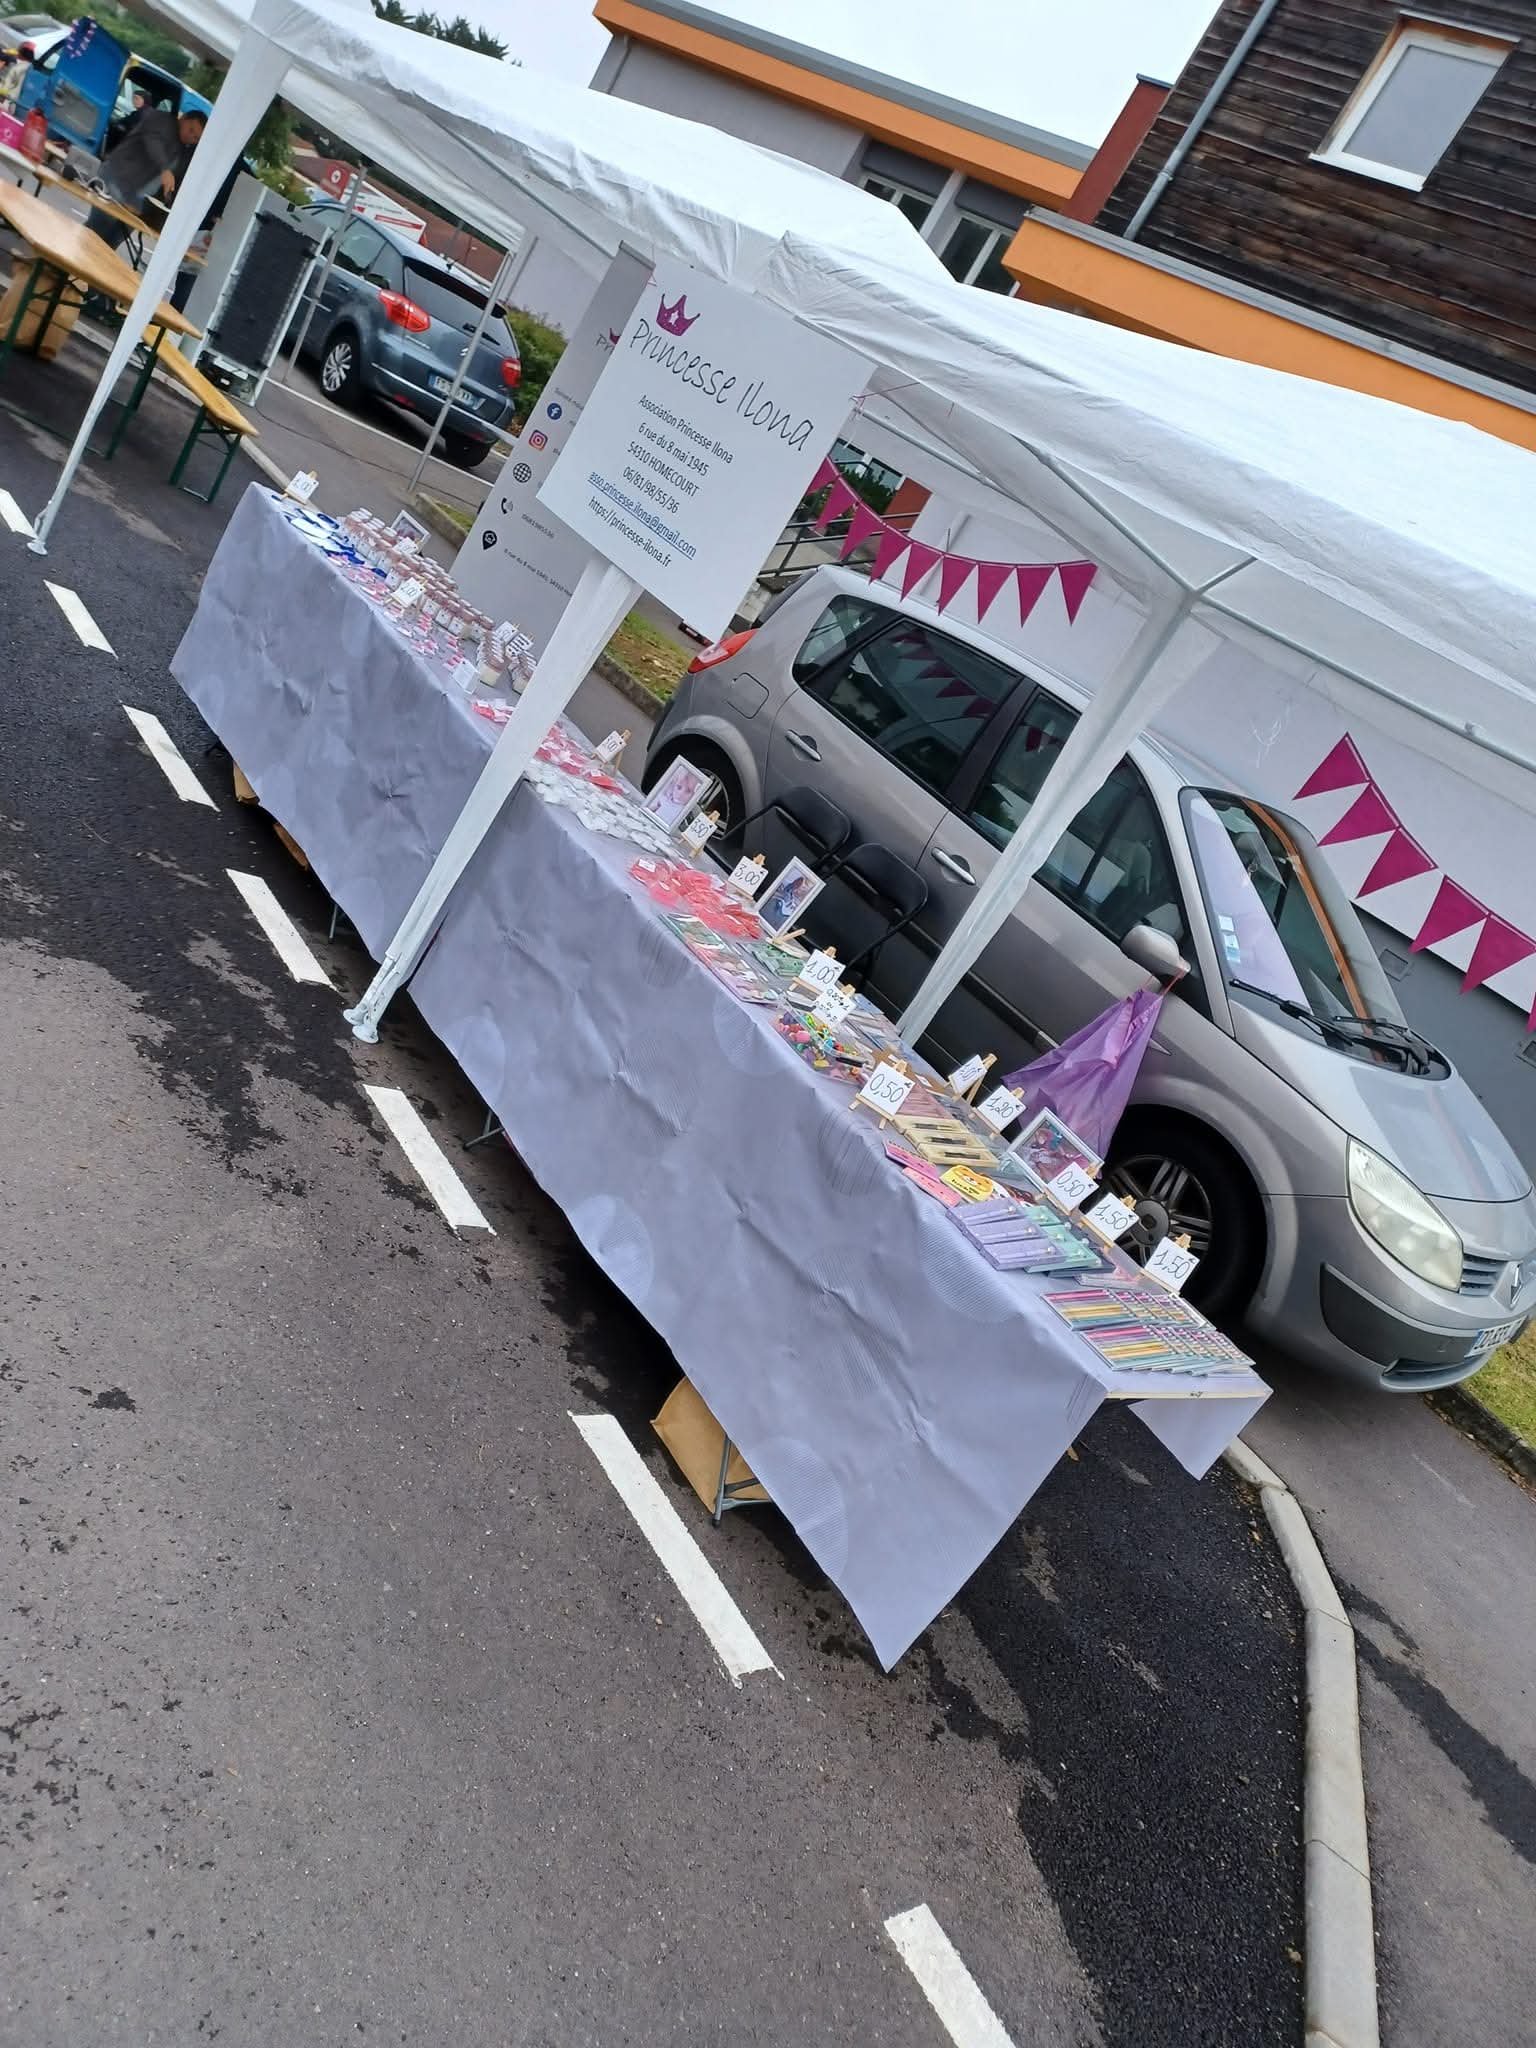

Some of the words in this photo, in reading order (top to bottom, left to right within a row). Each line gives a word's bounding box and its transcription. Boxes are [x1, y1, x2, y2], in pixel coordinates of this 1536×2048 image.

[629, 318, 737, 404] Princesse
[736, 381, 814, 452] Ilona
[638, 394, 678, 427] Association
[676, 418, 712, 450] Princesse
[711, 441, 734, 464] Ilona
[638, 422, 647, 434] 6
[643, 427, 658, 442] rue
[656, 434, 668, 449] du
[666, 441, 675, 453] 8
[672, 447, 691, 463] mai
[687, 455, 710, 476] 1945
[622, 466, 680, 514] 06/81/98/55/36
[627, 441, 651, 464] 54310
[648, 456, 700, 497] HOMECOURT
[588, 496, 672, 567] https://princesse-ilona.fr
